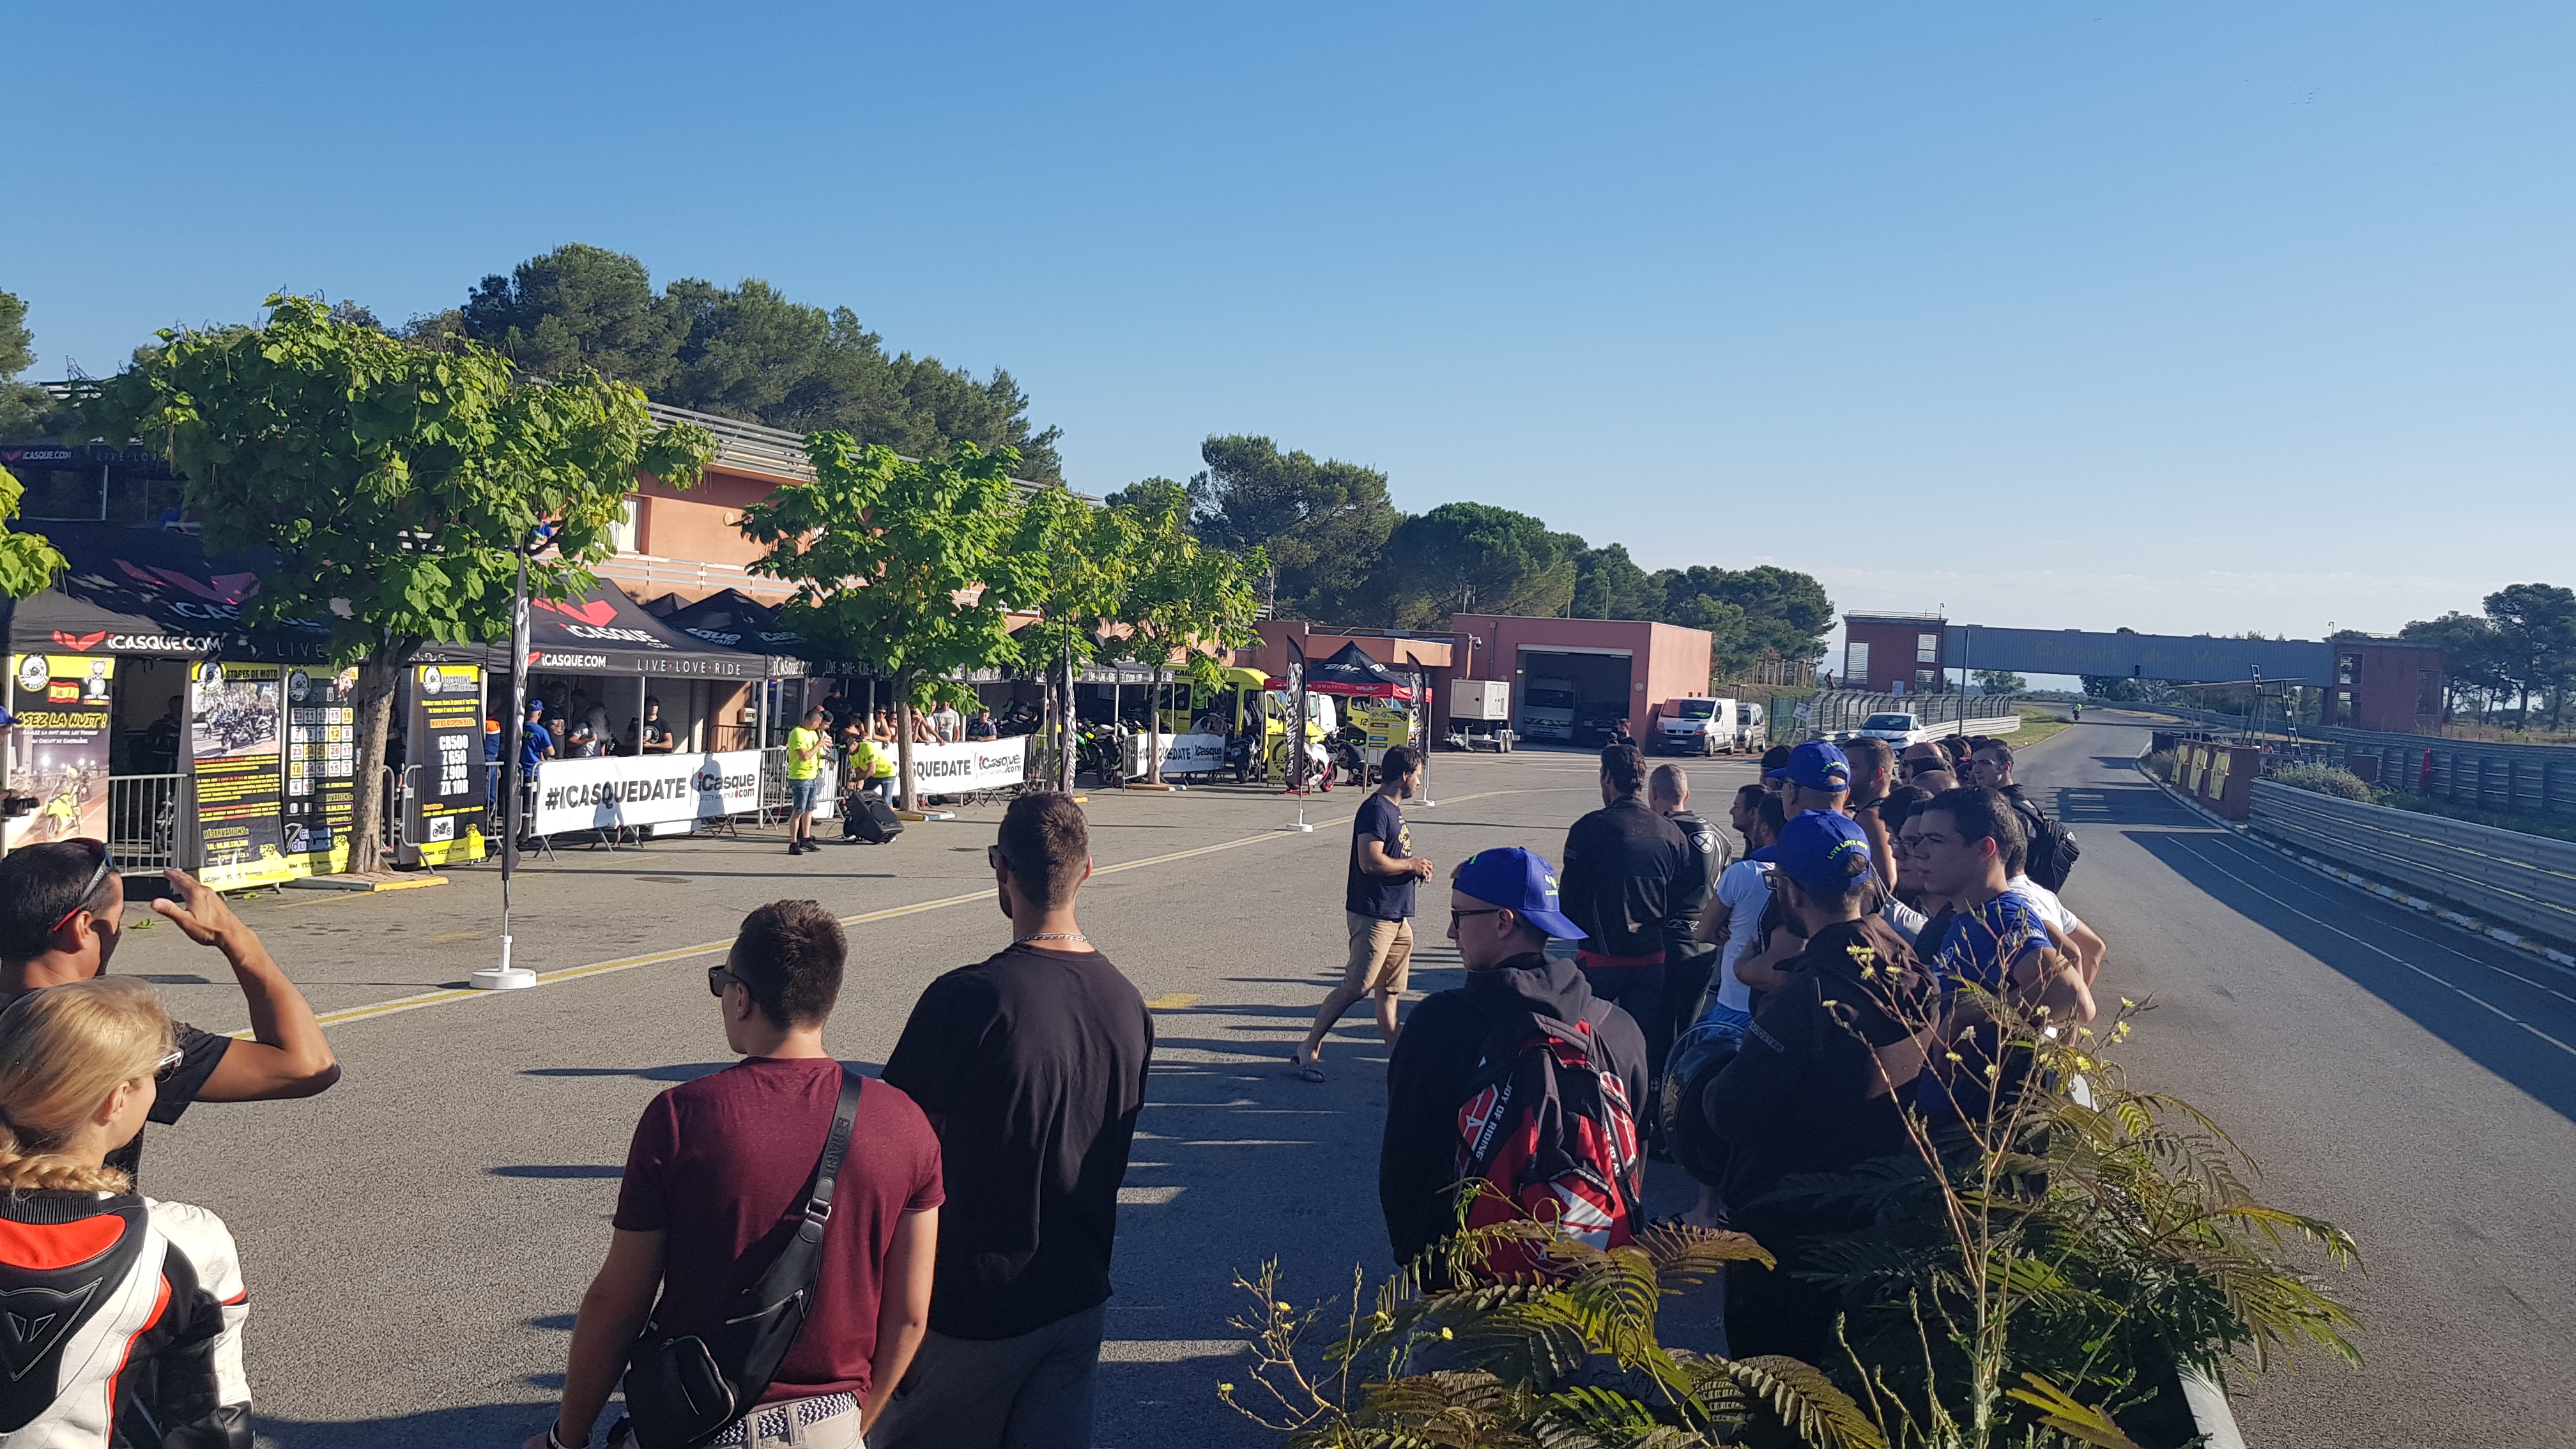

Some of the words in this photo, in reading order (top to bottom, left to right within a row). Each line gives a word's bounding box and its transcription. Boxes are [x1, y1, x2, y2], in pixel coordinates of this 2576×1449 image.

[541, 653, 607, 668] iCASQUE.COM
[638, 659, 666, 671] LIVE
[676, 660, 706, 673] LOVE
[714, 661, 741, 675] RIDE
[1324, 663, 1361, 672] Bihr
[226, 669, 250, 678] STAGES
[251, 670, 259, 678] DE
[259, 669, 279, 678] MOTO
[49, 712, 66, 728] LA
[439, 735, 469, 751] CB500
[443, 750, 448, 765] Z
[448, 749, 467, 765] 650
[979, 754, 1022, 770] iCasque
[443, 766, 448, 780] Z
[449, 765, 468, 779] 900
[440, 780, 451, 796] ZX
[452, 779, 469, 794] 10R
[698, 771, 756, 792] iCasque
[545, 777, 687, 811] #ICASQUEDATE
[292, 839, 307, 852] du
[1827, 845, 1841, 860] LIVE
[1494, 1105, 1505, 1121] OF
[1475, 1121, 1498, 1162] RIDING
